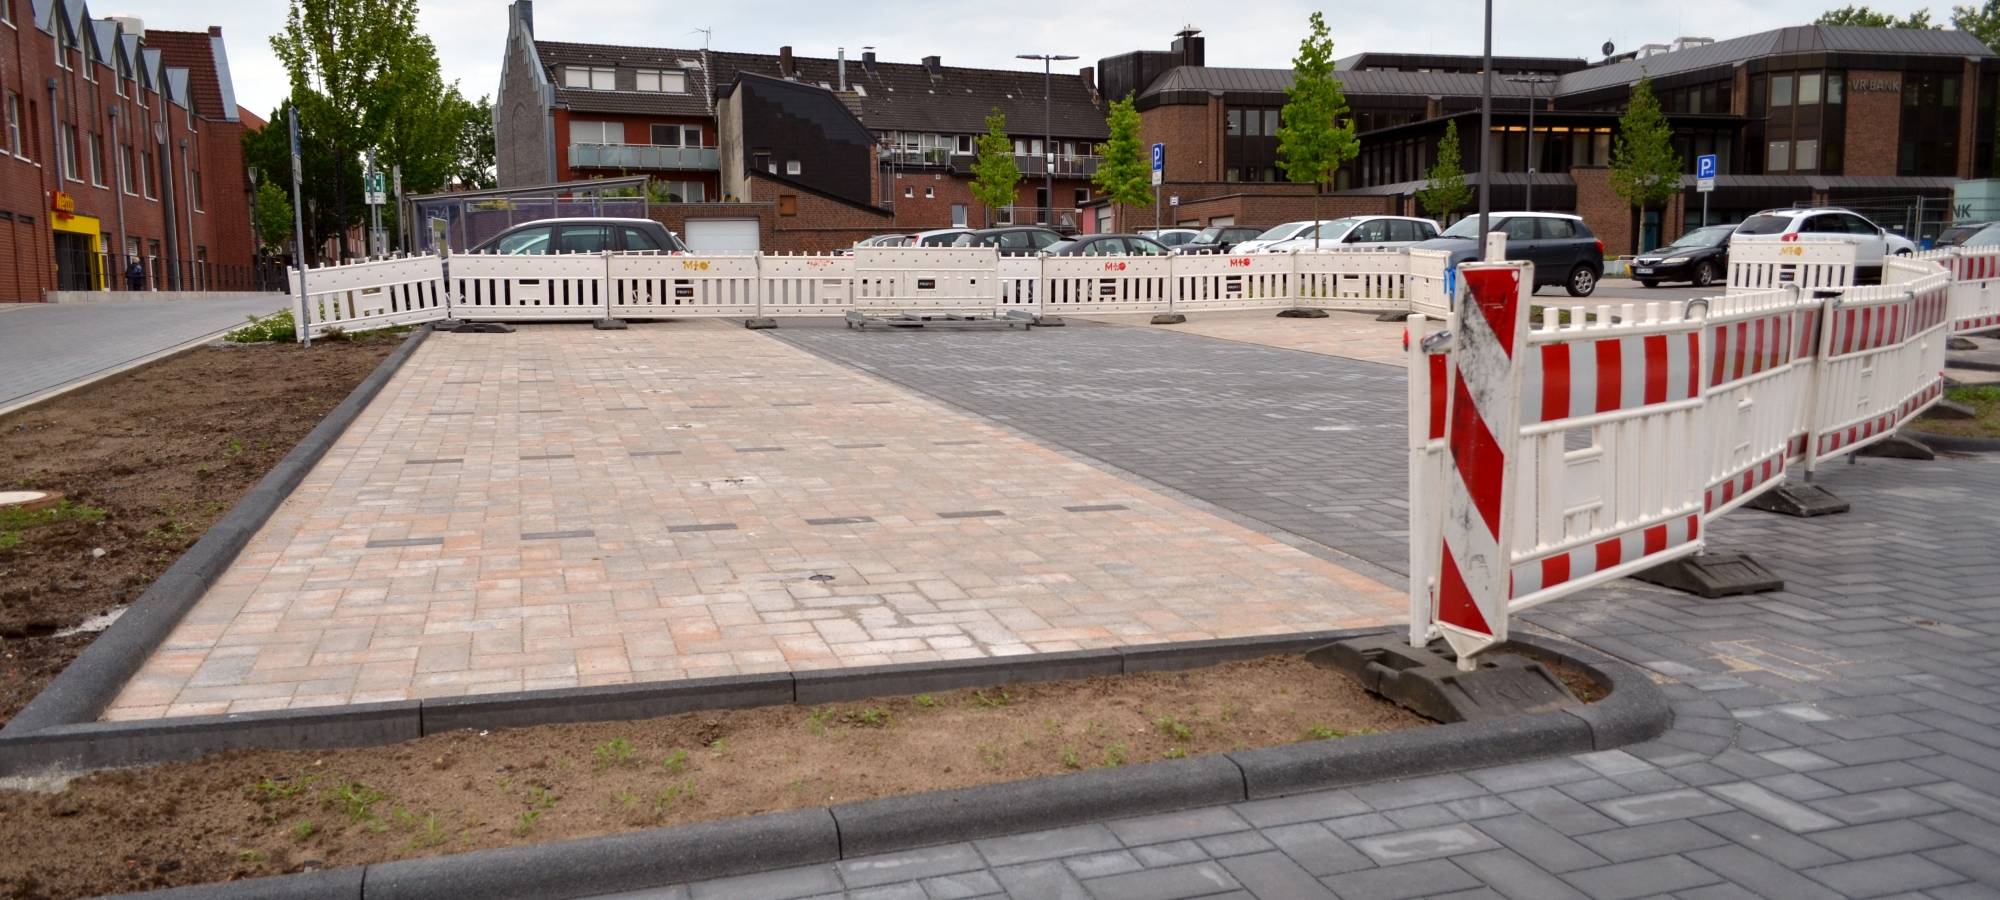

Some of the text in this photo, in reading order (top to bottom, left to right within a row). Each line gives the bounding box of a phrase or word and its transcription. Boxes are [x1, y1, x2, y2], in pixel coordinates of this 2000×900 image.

[1852, 79, 1900, 91] VR BANK
[1154, 147, 1160, 168] P
[1701, 158, 1711, 176] P
